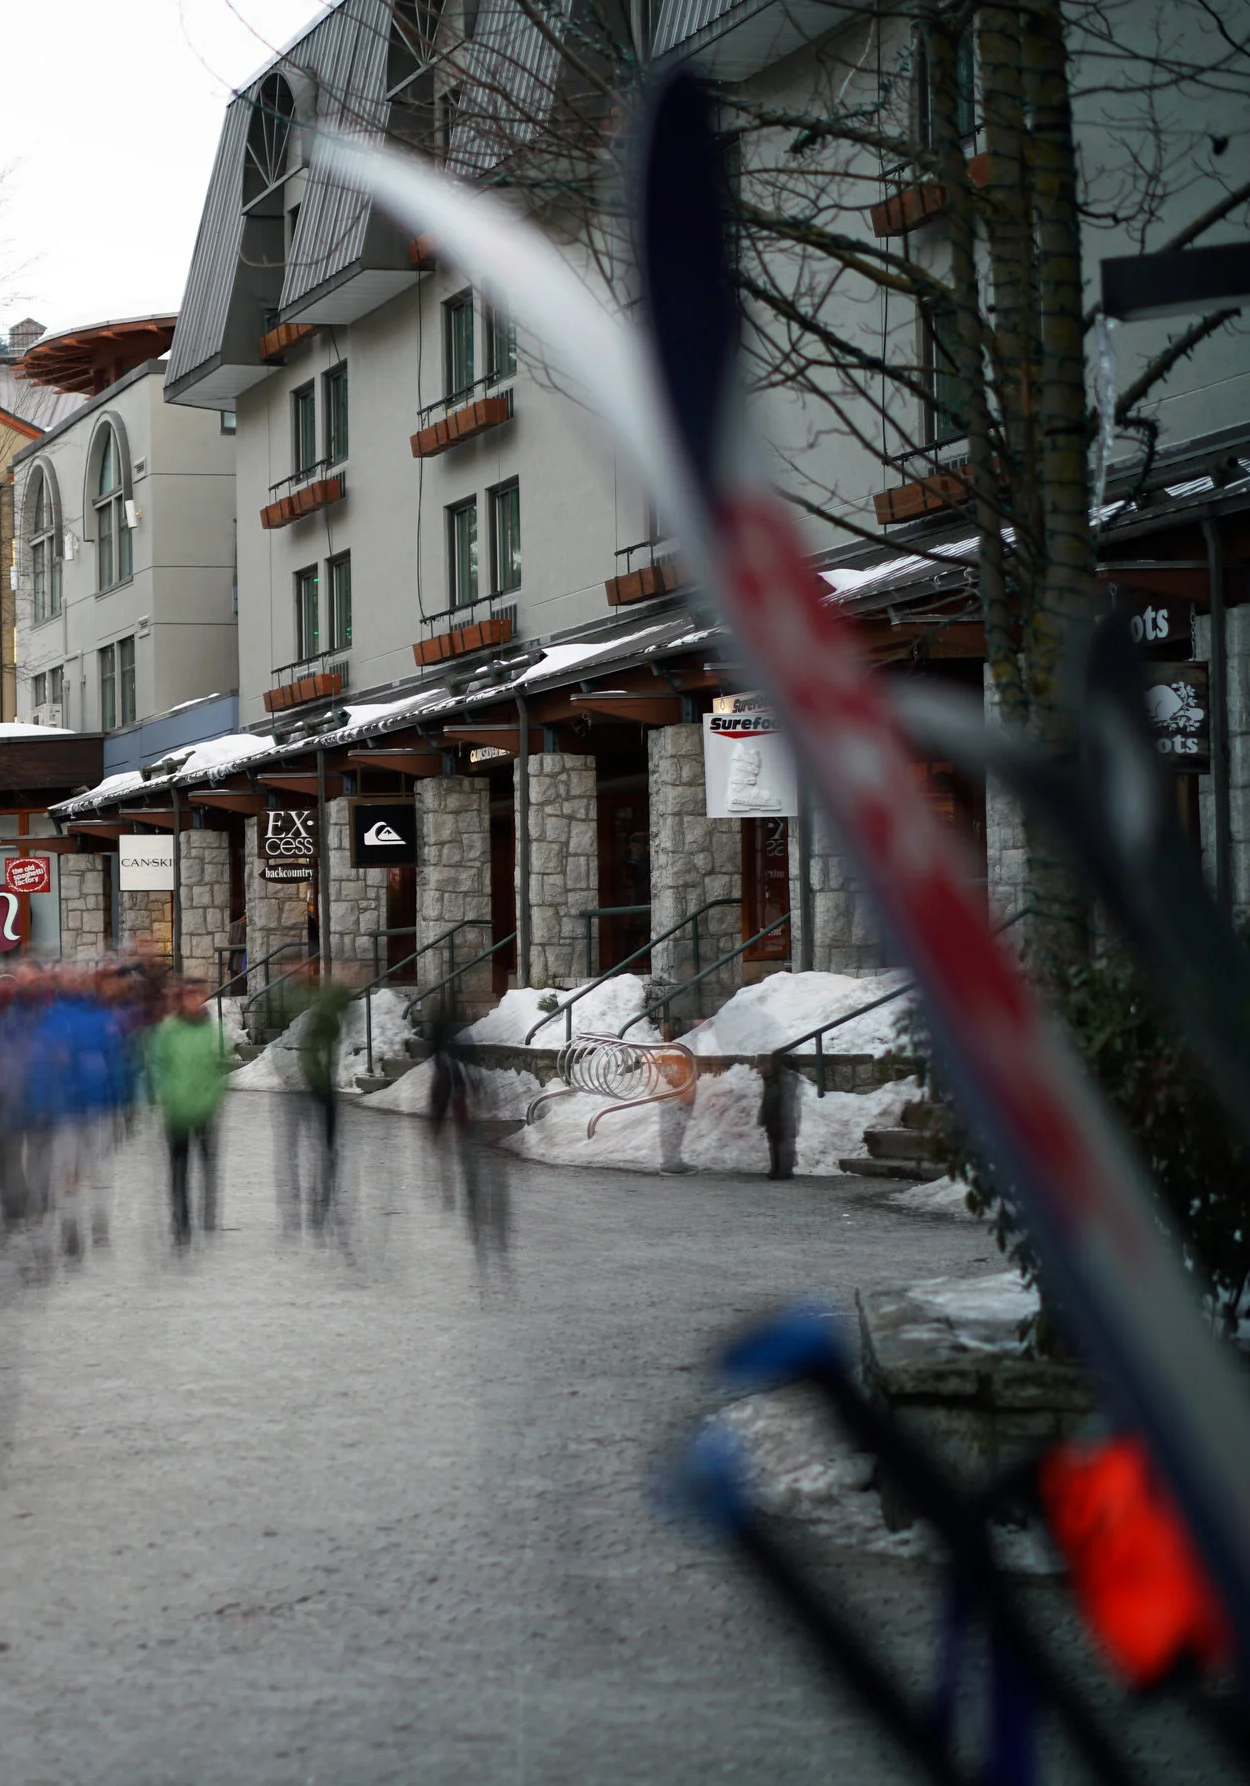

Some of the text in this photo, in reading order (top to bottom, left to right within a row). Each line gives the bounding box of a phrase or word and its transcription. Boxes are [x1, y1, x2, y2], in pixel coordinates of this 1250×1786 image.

[1130, 605, 1169, 643] ots
[1157, 735, 1199, 754] ots
[265, 838, 314, 855] cess
[13, 868, 44, 881] spaghetti
[24, 864, 35, 872] old
[265, 866, 314, 880] backcountry
[15, 876, 39, 886] factory
